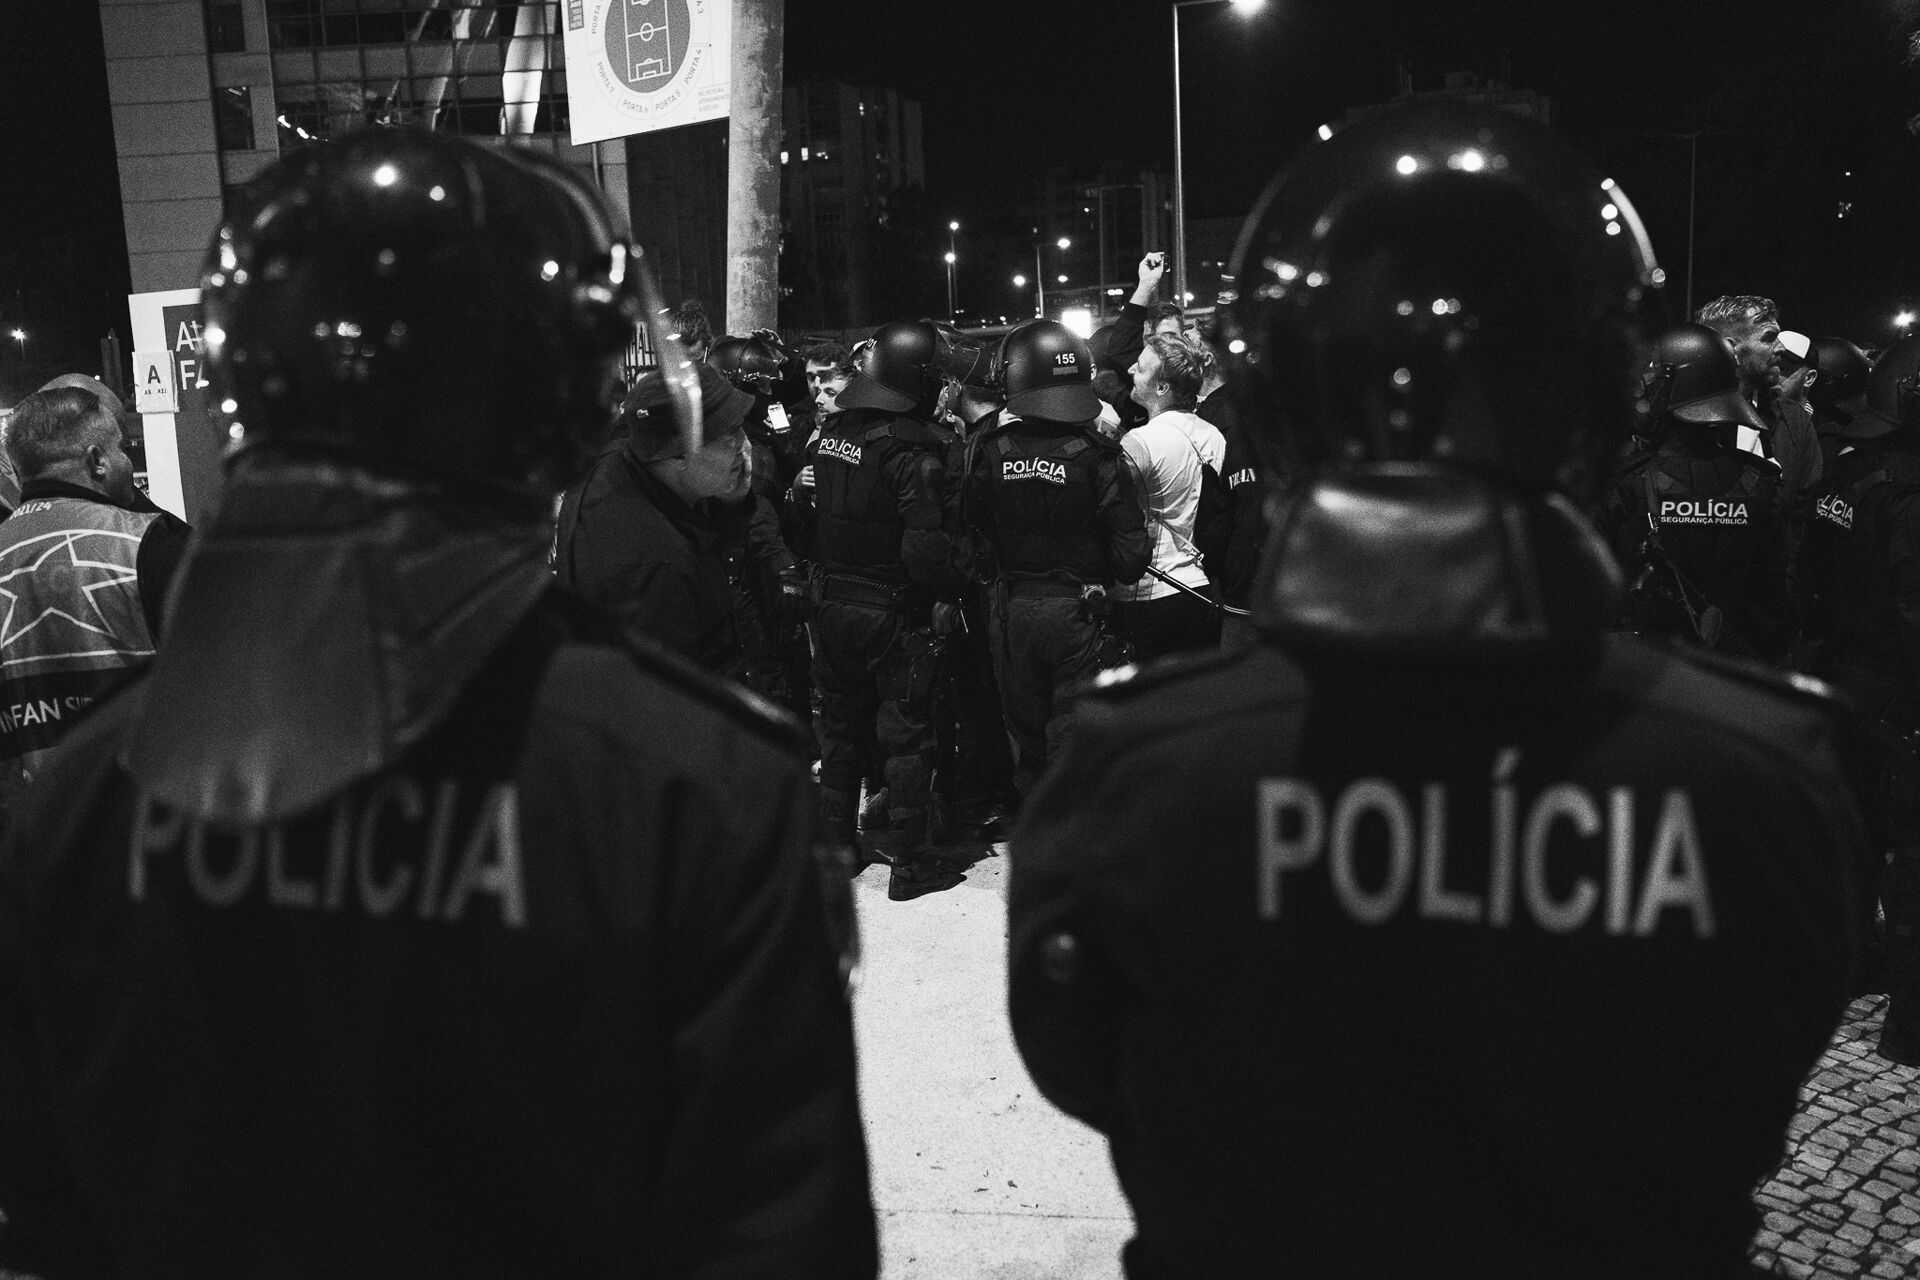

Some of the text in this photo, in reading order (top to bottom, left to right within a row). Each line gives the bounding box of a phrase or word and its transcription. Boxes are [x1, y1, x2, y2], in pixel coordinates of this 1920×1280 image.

[1055, 353, 1076, 365] 155
[147, 364, 161, 384] A
[1002, 457, 1066, 478] POLÍCIA
[1661, 498, 1748, 518] POLÍCIA
[1660, 516, 1748, 525] SEGURANÇA PÚBLICA
[1256, 747, 1717, 939] POLÍCIA
